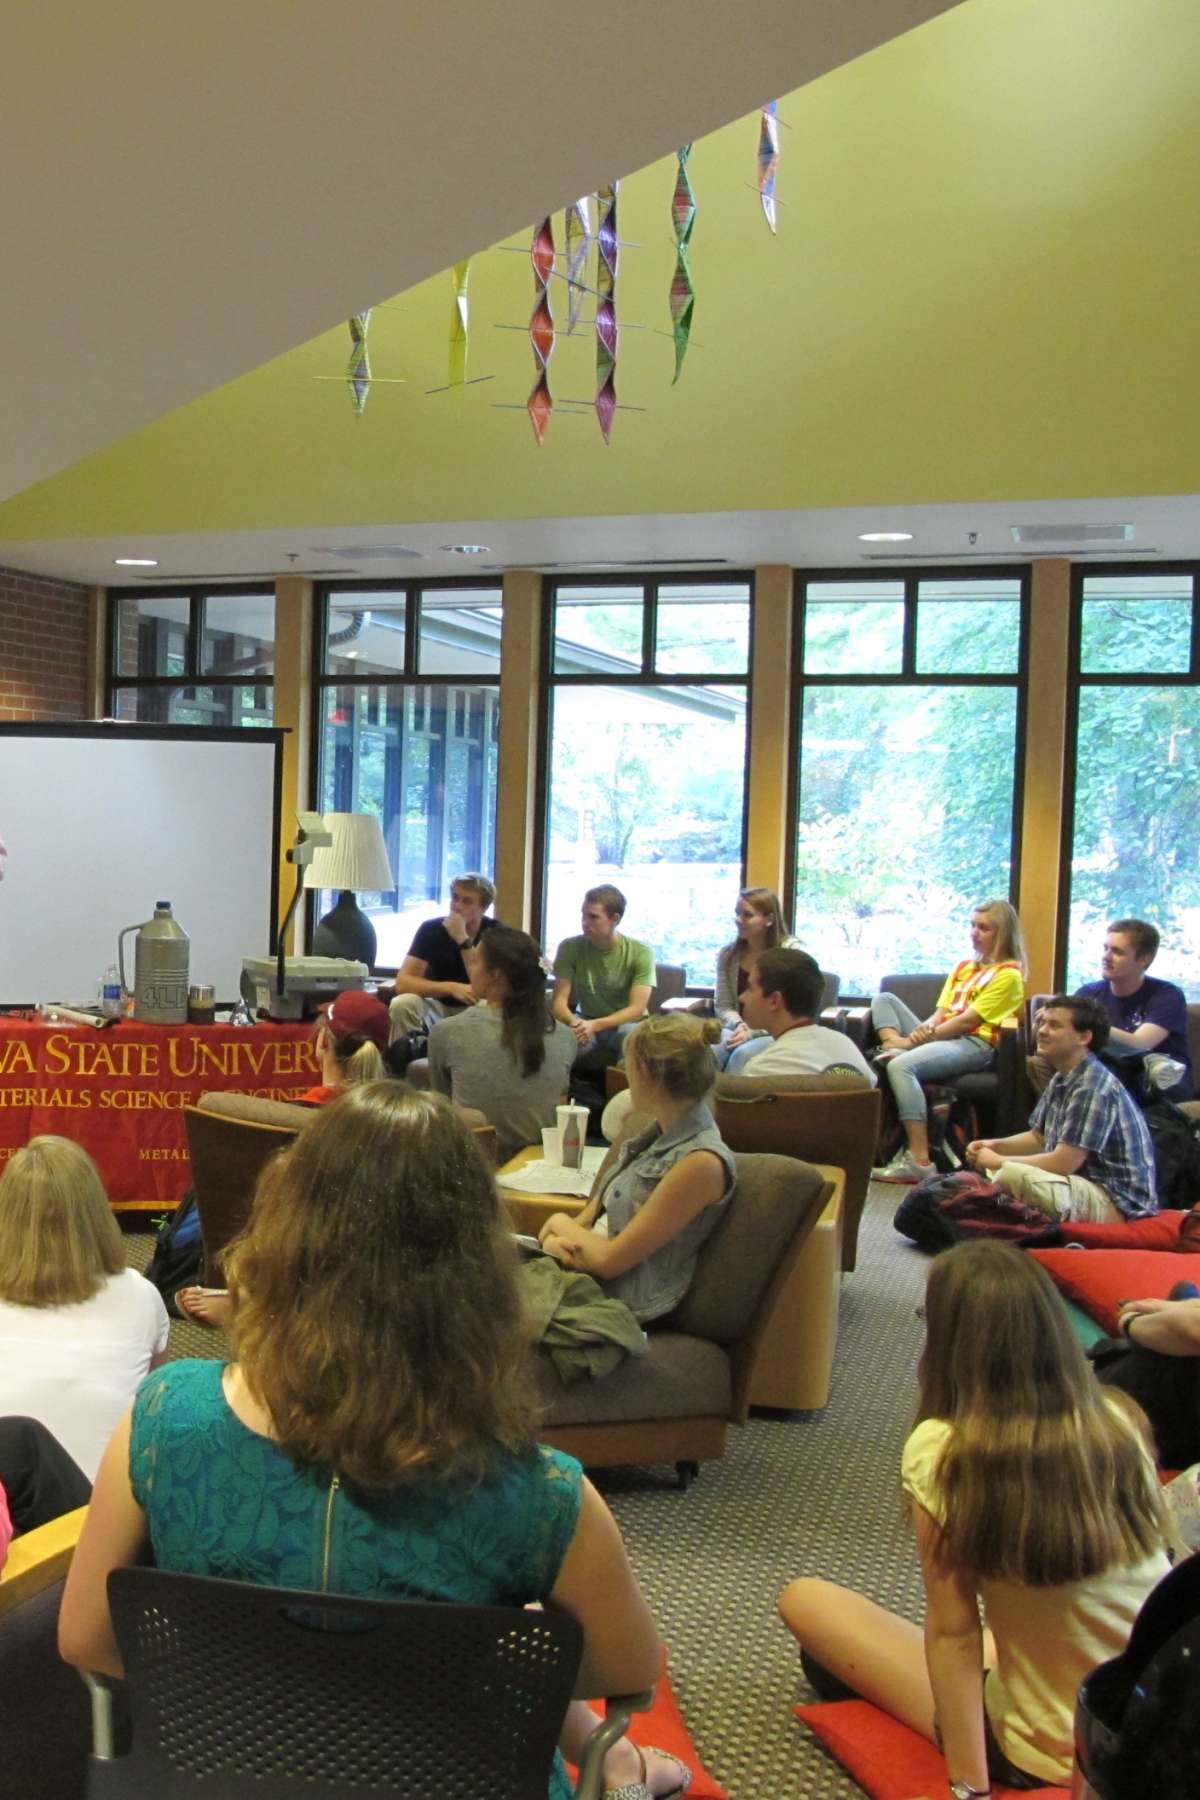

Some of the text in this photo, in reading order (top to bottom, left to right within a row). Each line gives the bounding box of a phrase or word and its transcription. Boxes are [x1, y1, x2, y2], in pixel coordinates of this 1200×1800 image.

[45, 1034, 161, 1076] STATE
[167, 1036, 323, 1078] UNIVER
[98, 1089, 192, 1110] SCIENCE
